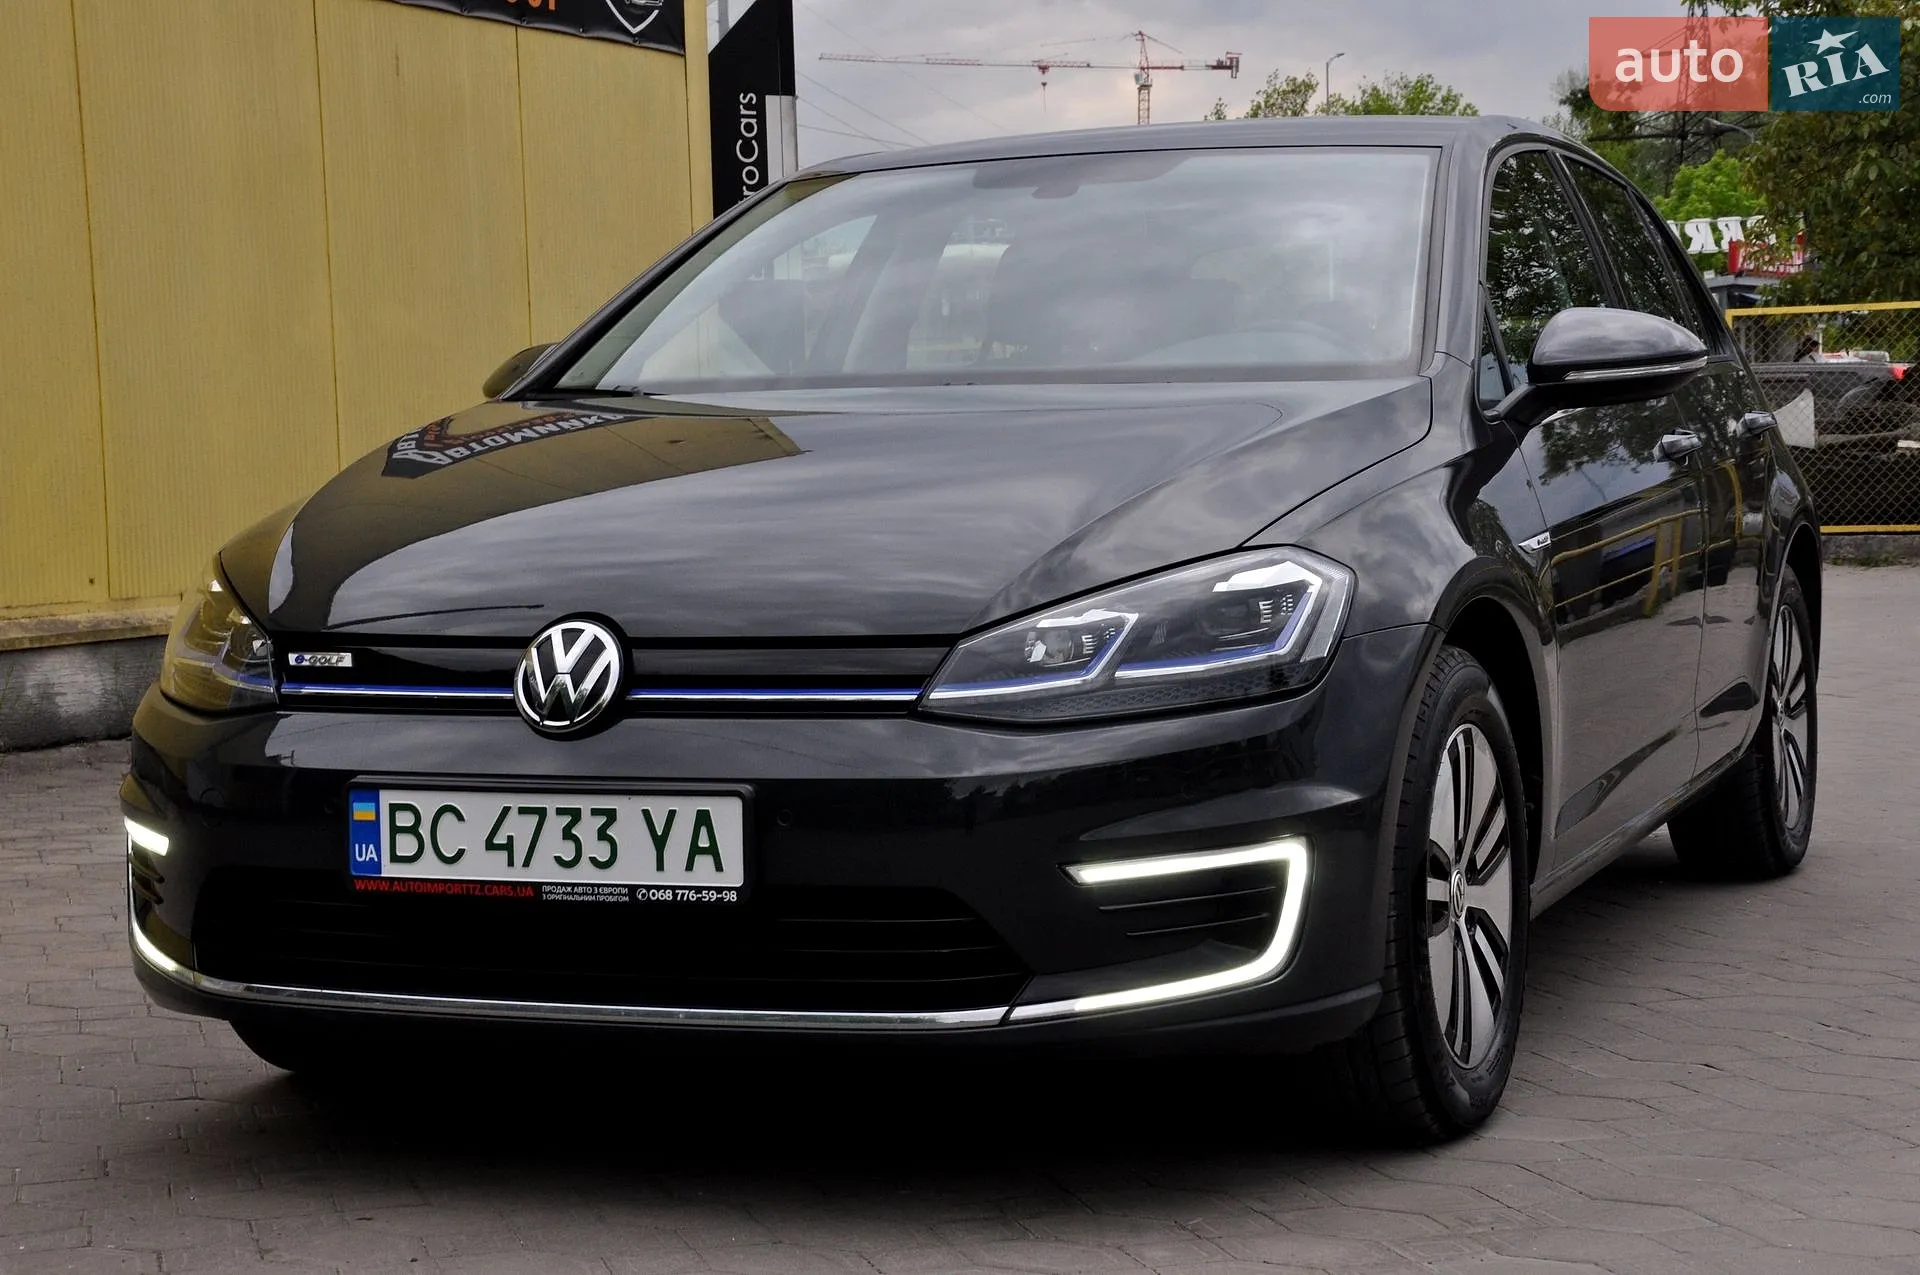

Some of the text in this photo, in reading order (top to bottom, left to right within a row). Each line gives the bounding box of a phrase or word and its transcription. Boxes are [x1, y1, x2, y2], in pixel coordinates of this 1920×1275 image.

[735, 92, 760, 200] roCars
[388, 802, 724, 872] BC 4733 YA
[355, 843, 378, 862] UA
[542, 885, 572, 893] ПРОДАЖ
[573, 886, 592, 894] АВТО
[649, 889, 737, 902] 068 776-59-98
